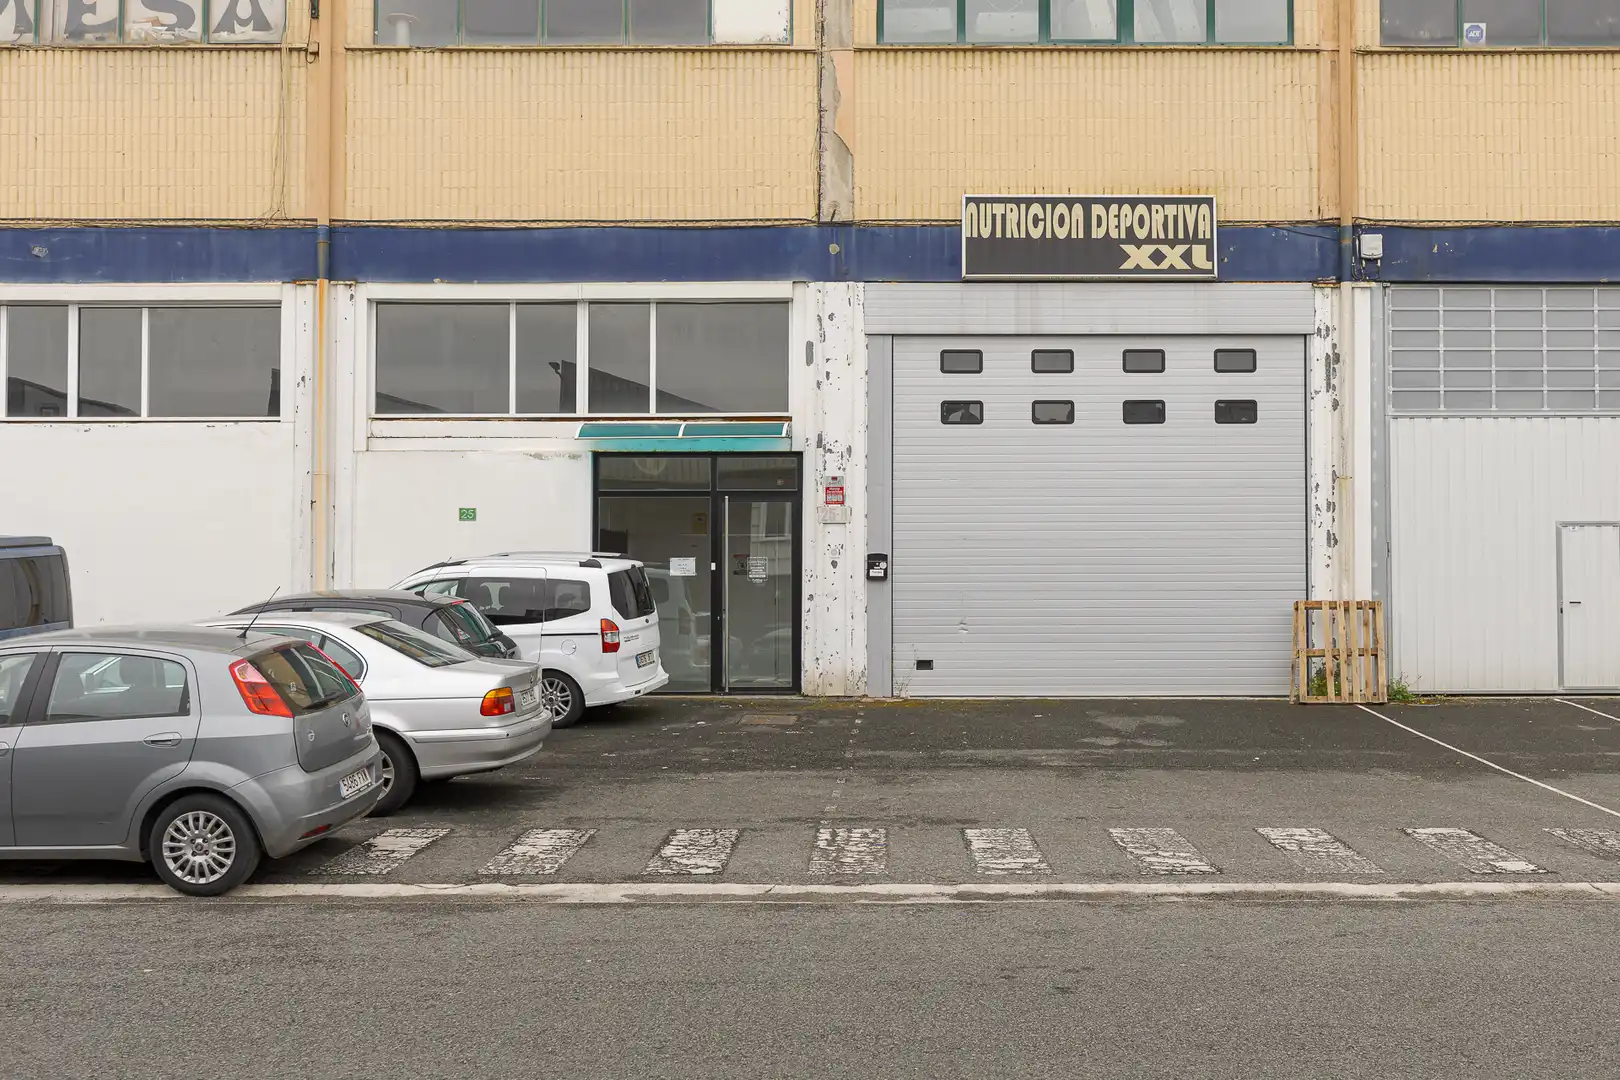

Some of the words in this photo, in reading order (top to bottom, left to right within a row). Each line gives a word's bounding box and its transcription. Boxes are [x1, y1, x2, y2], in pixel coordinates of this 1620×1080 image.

[965, 202, 1084, 239] NUTRICION
[1091, 203, 1211, 240] DEPORTIVA
[1118, 244, 1213, 270] XXL
[460, 509, 474, 519] 25
